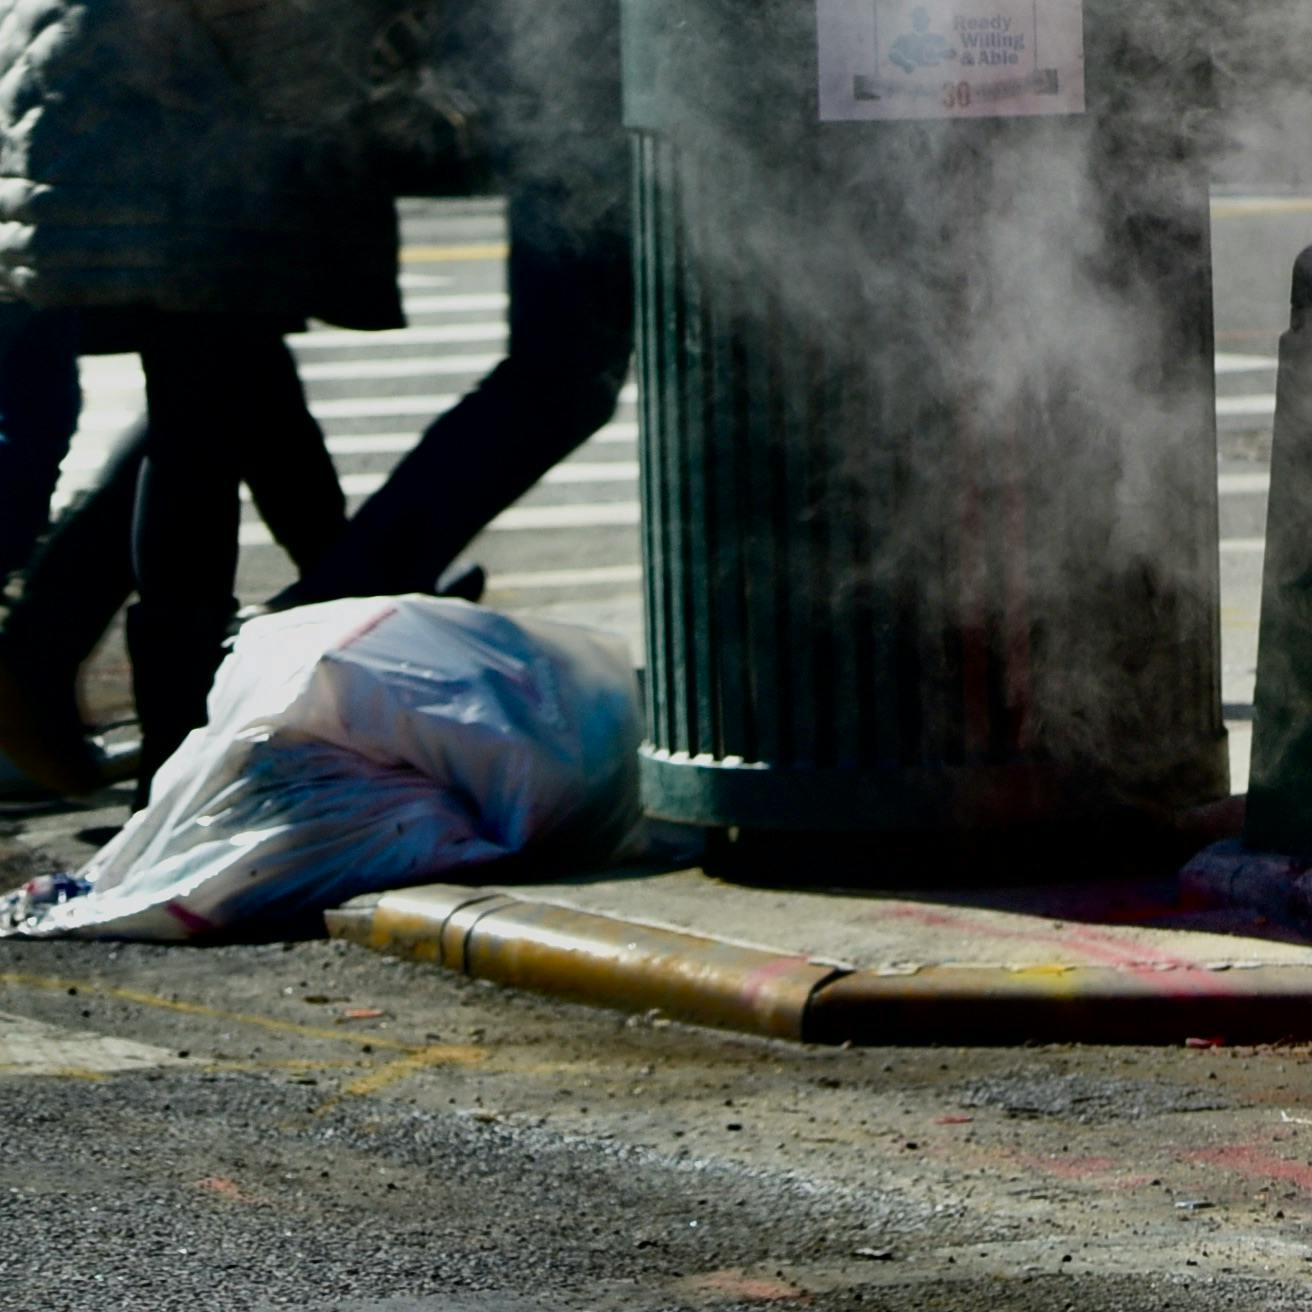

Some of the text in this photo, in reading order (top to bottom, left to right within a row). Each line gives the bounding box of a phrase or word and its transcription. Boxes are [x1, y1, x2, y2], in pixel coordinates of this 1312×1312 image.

[953, 15, 1013, 33] Ready
[960, 31, 1025, 51] Willing
[960, 50, 1019, 66] & Able
